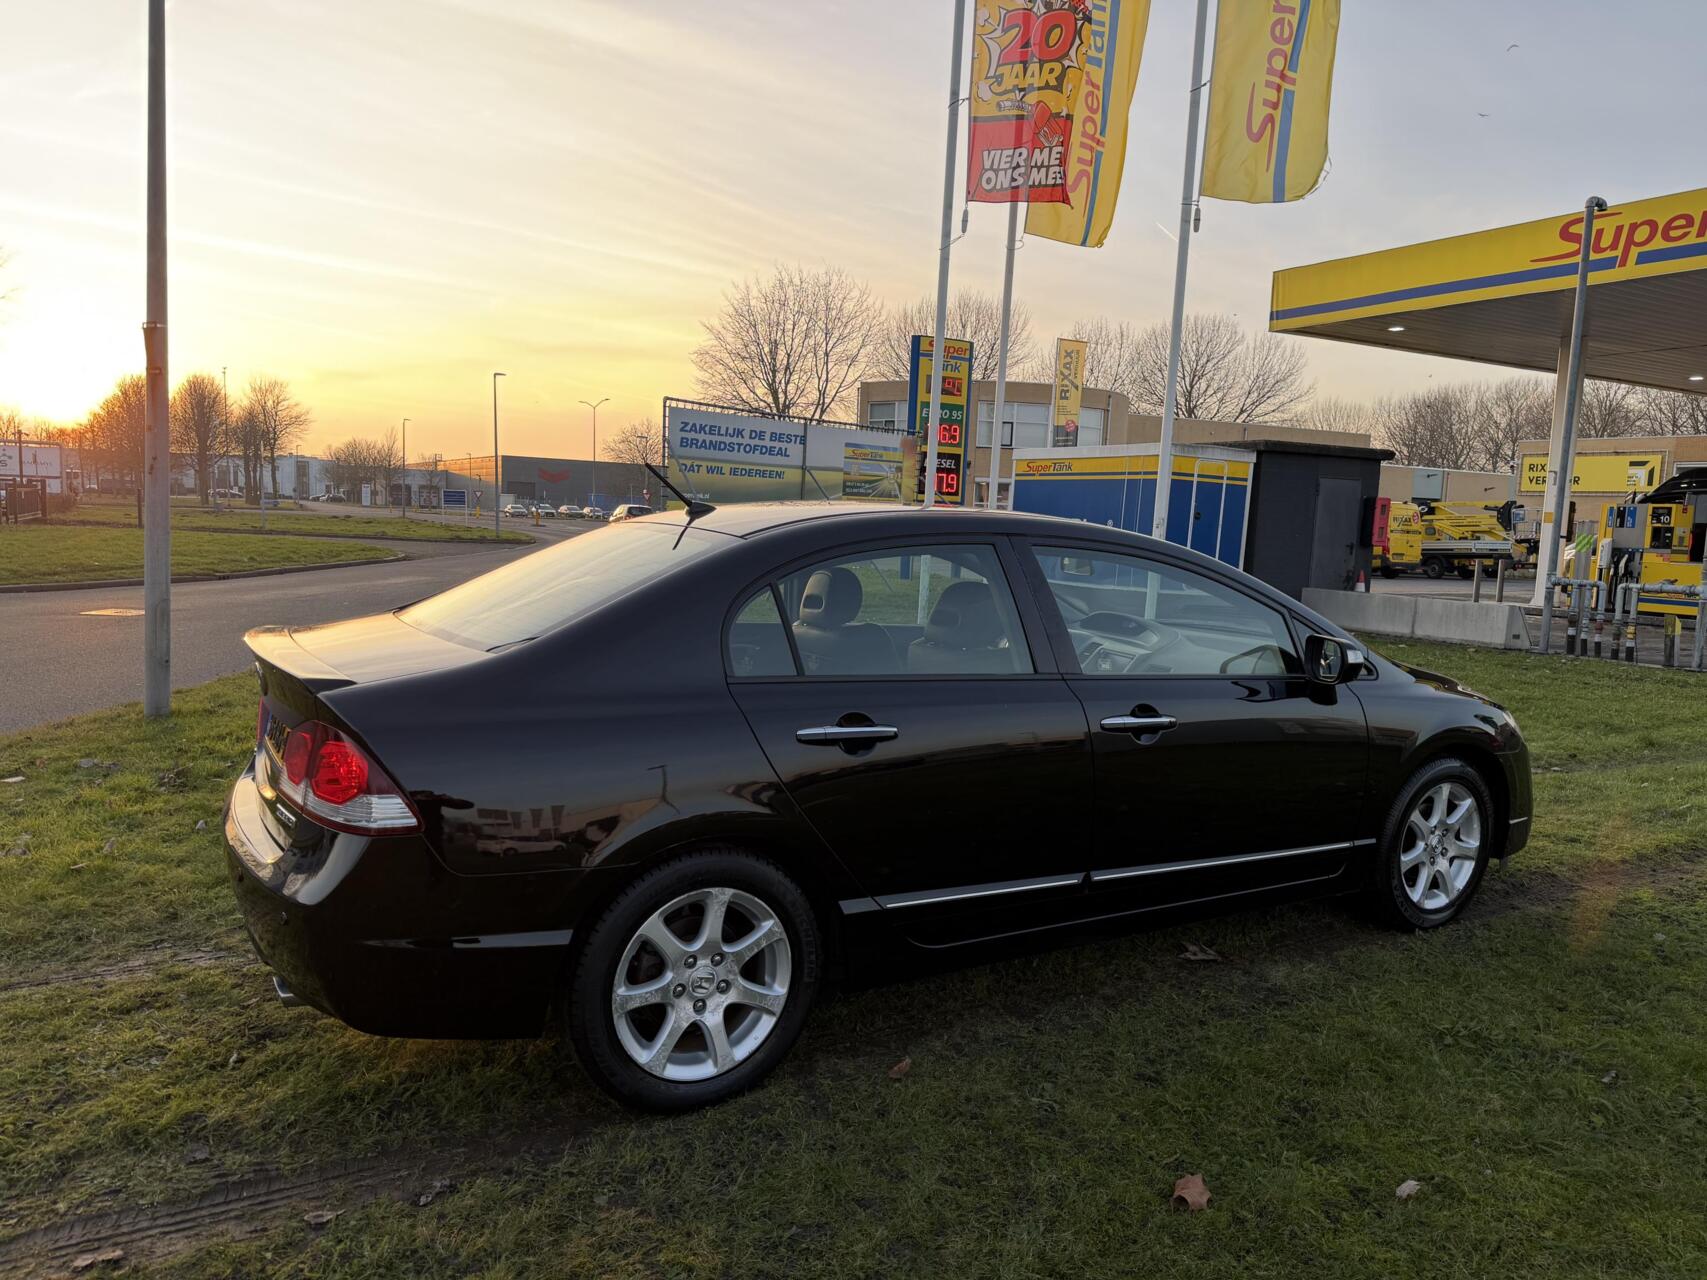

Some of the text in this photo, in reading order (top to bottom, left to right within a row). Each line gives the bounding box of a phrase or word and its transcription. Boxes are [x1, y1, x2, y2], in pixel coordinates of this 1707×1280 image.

[999, 8, 1077, 63] 20
[991, 61, 1062, 94] JAAR
[982, 145, 1064, 169] VIER ME
[981, 166, 1027, 191] ONS
[951, 410, 963, 420] 95
[679, 421, 806, 446] ZAKELIJK DE BESTE
[679, 436, 791, 458] BRANDSTOFDEAL
[706, 465, 726, 476] WIL
[729, 466, 785, 480] IEDEREEN!
[1023, 460, 1073, 475] SuperTank
[1528, 463, 1547, 473] RIX
[1660, 515, 1670, 524] 10
